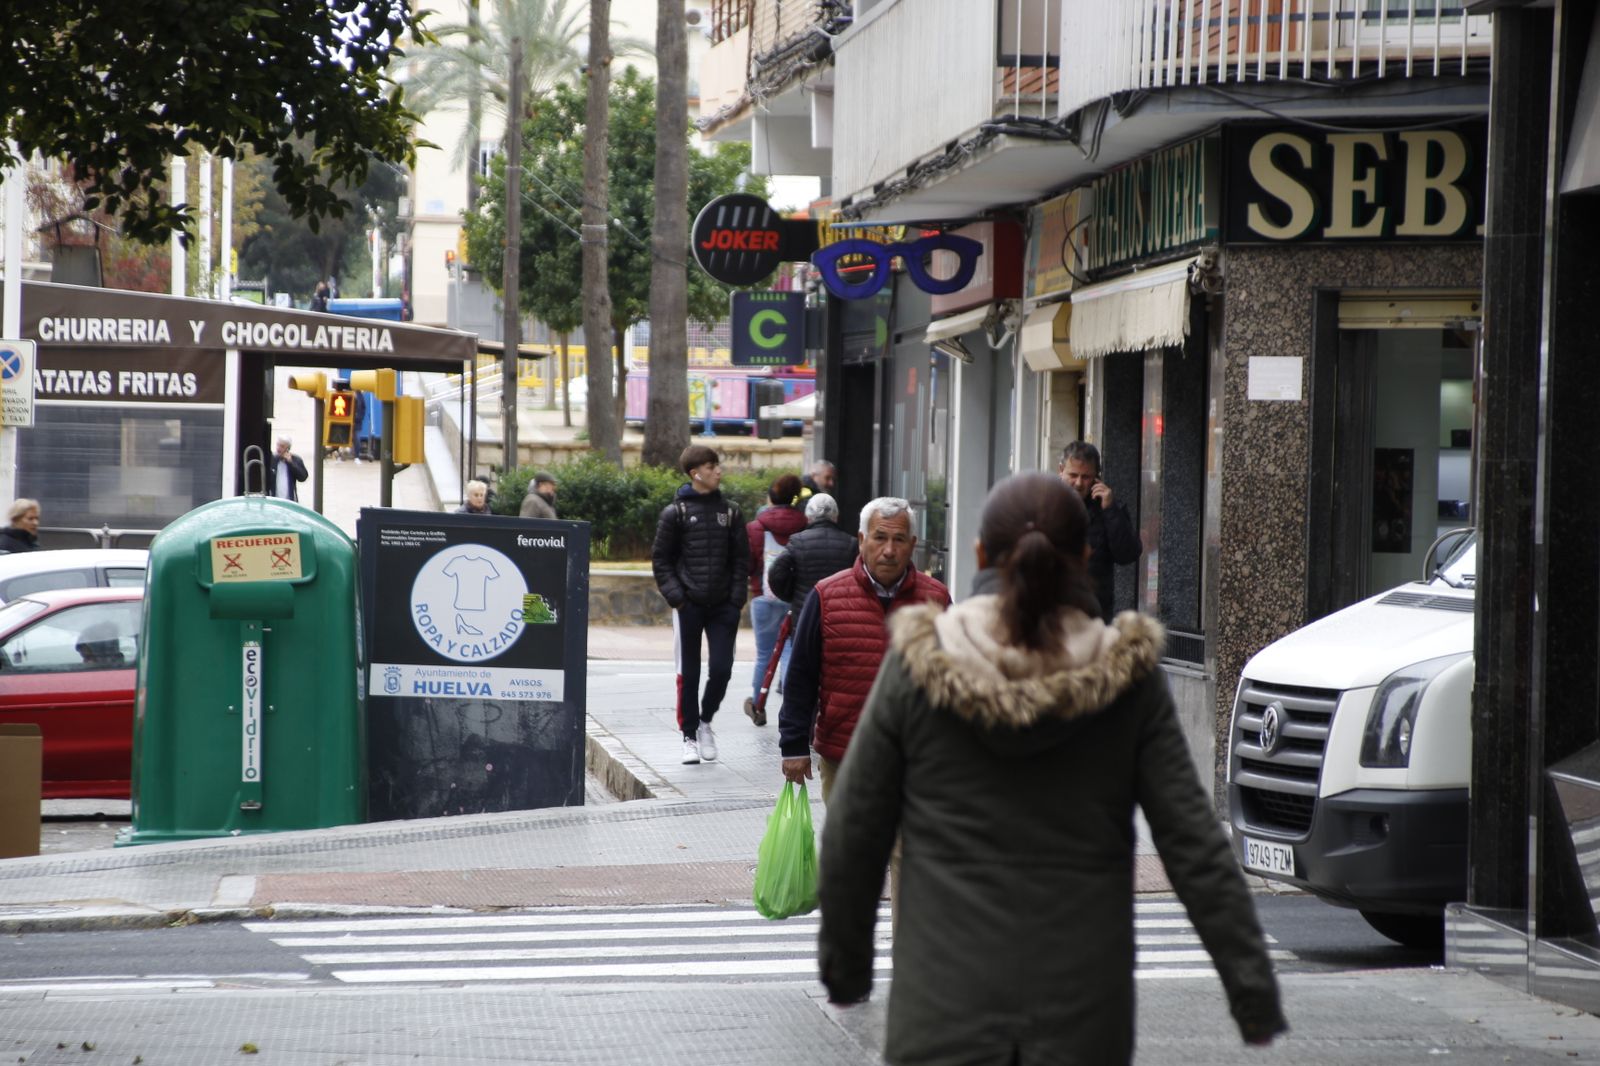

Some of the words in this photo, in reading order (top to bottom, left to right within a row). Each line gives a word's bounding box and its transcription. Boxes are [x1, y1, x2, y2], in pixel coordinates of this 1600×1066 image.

[1247, 131, 1485, 239] SEB
[1089, 160, 1144, 269] REGALOS
[702, 229, 780, 251] JOKER
[38, 317, 171, 343] CHURRERIA
[189, 319, 205, 344] Y
[221, 320, 394, 352] CHOCOLATERIA
[34, 368, 112, 396] ATATAS
[118, 371, 197, 397] FRITAS
[216, 536, 293, 549] RECUERDA
[517, 534, 565, 548] ferrovial
[415, 602, 443, 647] ROPA
[446, 639, 457, 654] Y
[460, 607, 524, 658] CALZADO
[413, 680, 492, 696] HUELVA
[415, 668, 477, 679] Ayuntamiento
[480, 669, 492, 678] de
[509, 678, 543, 687] AVISOS
[245, 649, 257, 780] ecovidrio
[1249, 843, 1271, 868] 9749
[1273, 847, 1292, 872] FZM
